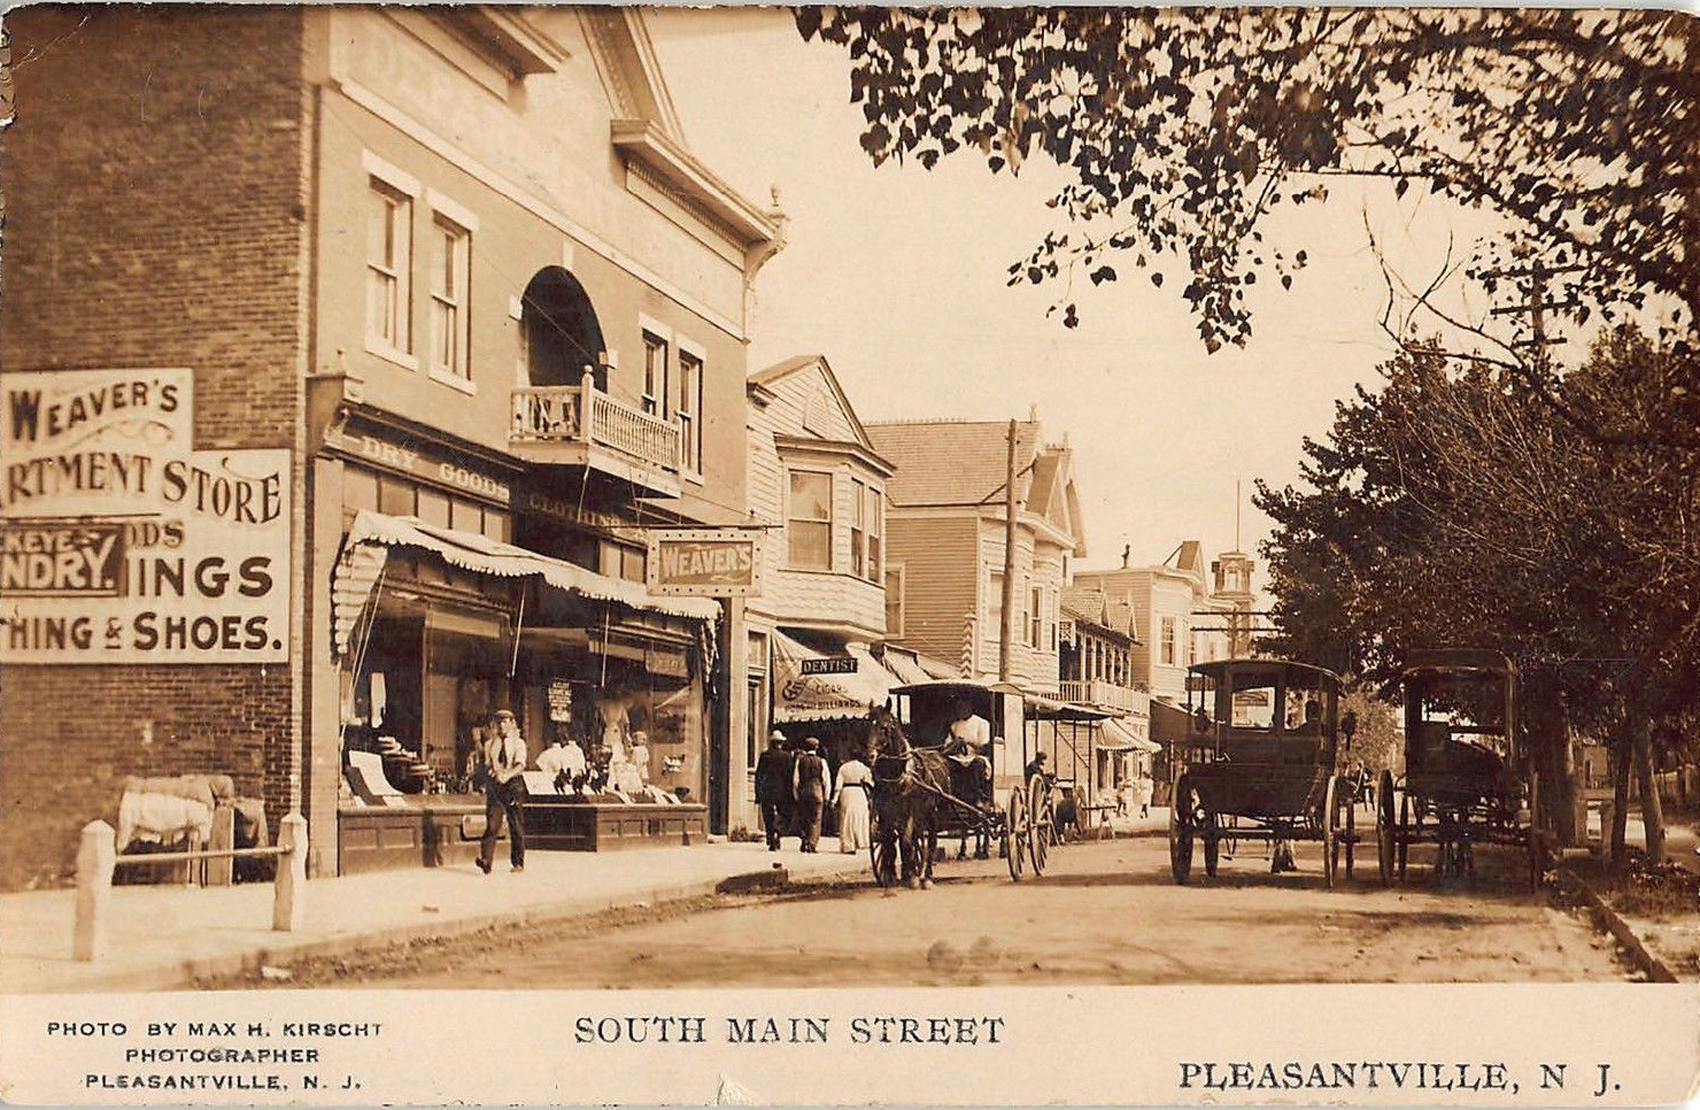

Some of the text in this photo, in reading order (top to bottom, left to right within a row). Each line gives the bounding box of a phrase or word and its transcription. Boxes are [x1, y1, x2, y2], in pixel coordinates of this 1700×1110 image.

[10, 379, 179, 442] WEAVER'S
[163, 459, 281, 524] STORE
[362, 435, 419, 469] DRY
[438, 462, 510, 503] GOODS
[1, 534, 118, 589] NDRY.
[126, 557, 273, 598] INGS
[105, 616, 121, 650] &
[133, 611, 282, 651] SHOES.
[804, 660, 855, 672] DENTIST
